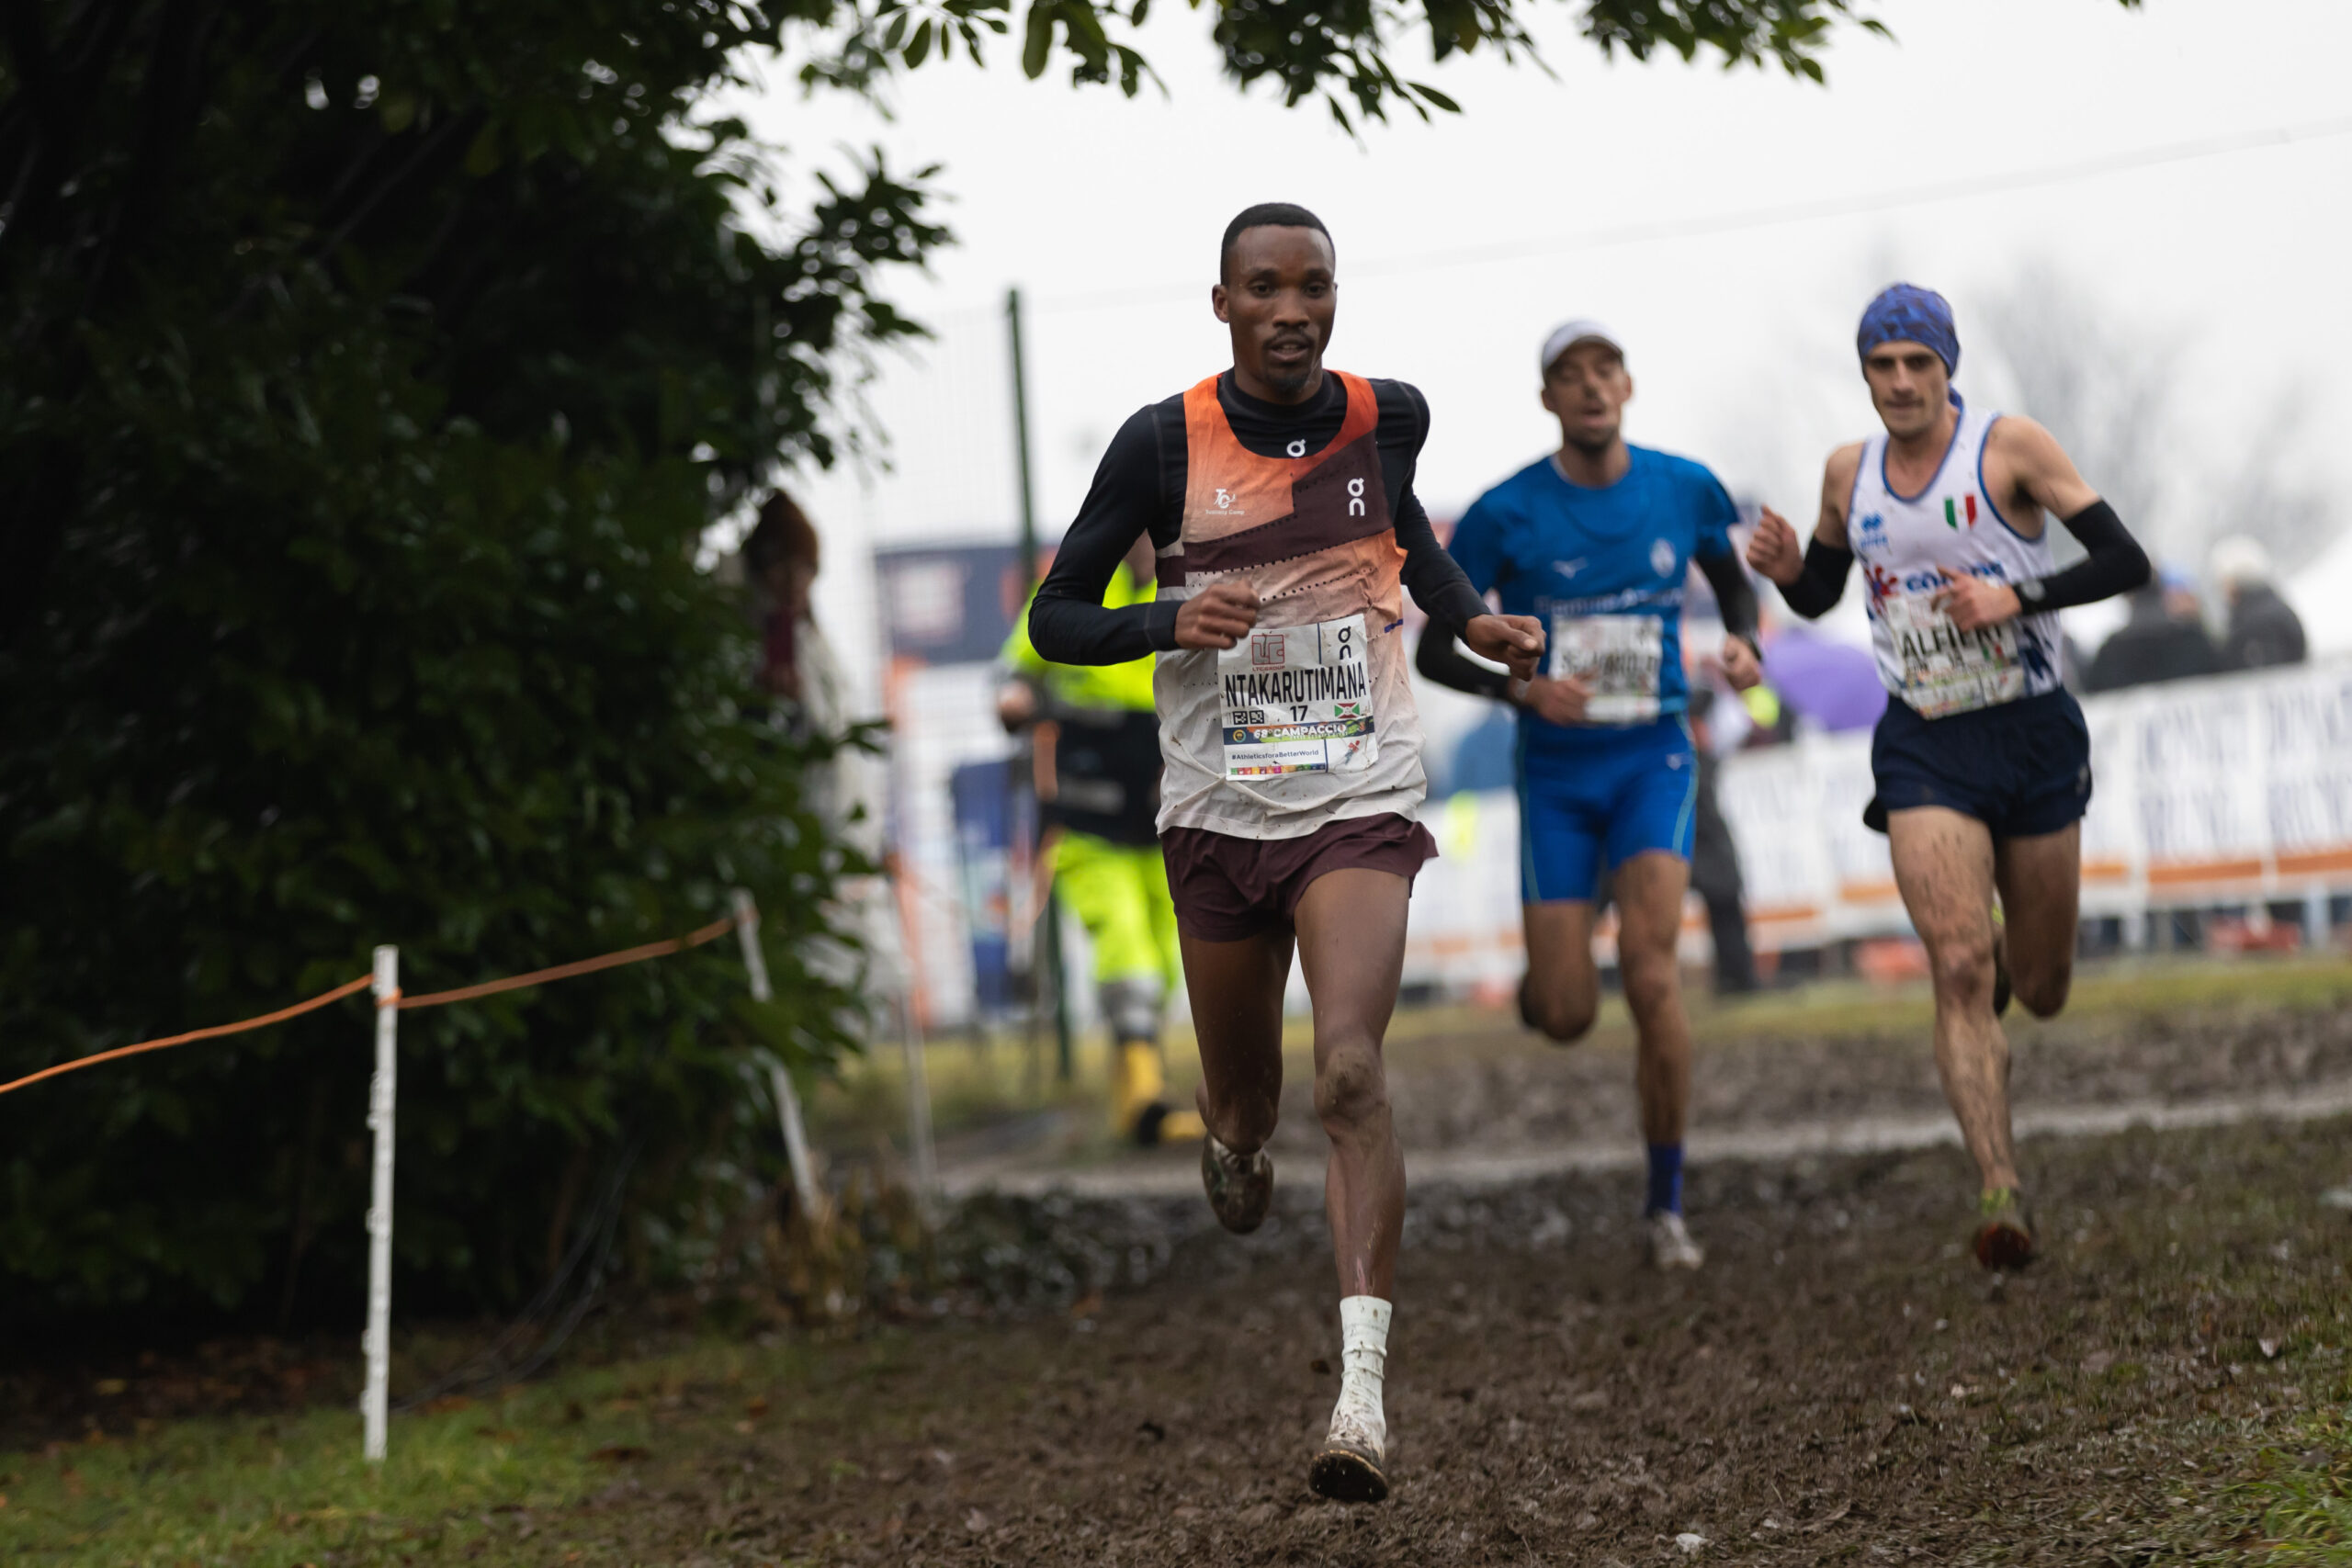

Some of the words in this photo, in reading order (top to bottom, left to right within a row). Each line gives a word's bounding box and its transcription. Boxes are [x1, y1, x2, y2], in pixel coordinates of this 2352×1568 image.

[1226, 661, 1366, 707] NTAKARUTIMANA
[1290, 705, 1308, 721] 17
[1273, 724, 1347, 737] CAMPACCIO
[1231, 750, 1319, 760] #AthleticsforaBetterWorld
